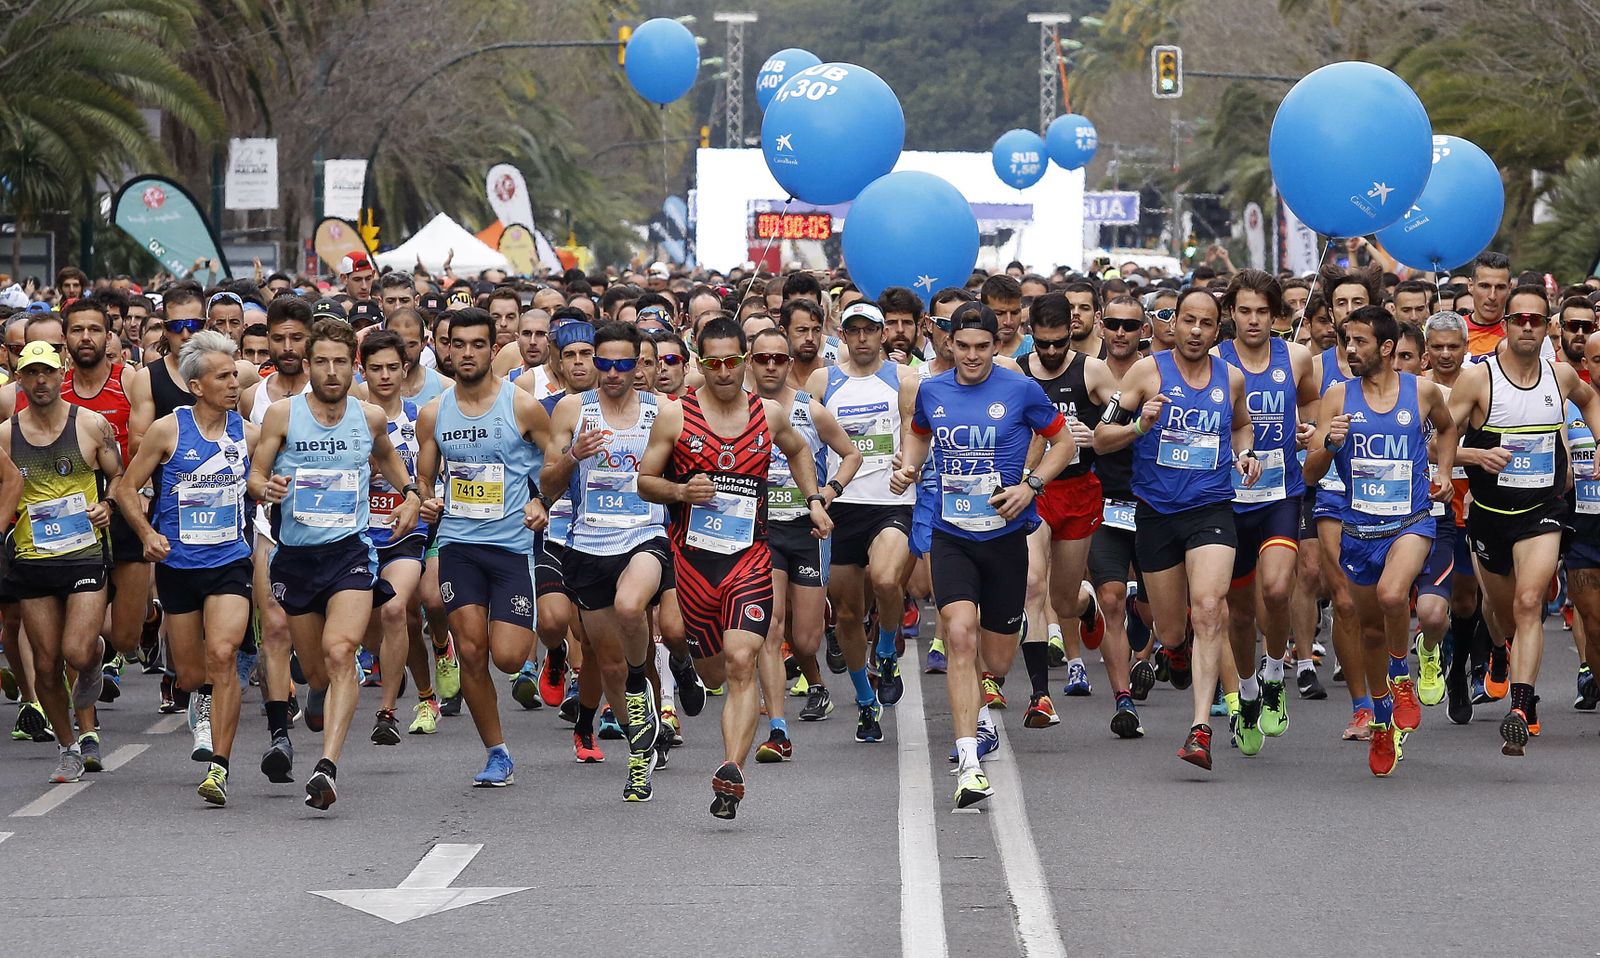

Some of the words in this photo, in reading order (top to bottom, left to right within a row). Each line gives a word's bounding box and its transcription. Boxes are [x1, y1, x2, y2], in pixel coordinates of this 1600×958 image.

[1011, 151, 1039, 164] SUB
[757, 213, 832, 241] 00:00:05
[1168, 405, 1221, 433] RCM
[442, 426, 489, 443] nerja
[937, 425, 996, 450] RCM
[295, 437, 348, 455] nerja
[1352, 433, 1409, 460] RCM
[303, 455, 342, 463] ATLETISMO
[1172, 448, 1189, 462] 80
[1513, 456, 1531, 470] 85
[456, 482, 485, 498] 7413
[1361, 482, 1386, 496] 164
[314, 494, 324, 507] 7
[368, 496, 395, 509] 531
[597, 495, 623, 508] 134
[955, 498, 971, 512] 69
[190, 511, 216, 524] 107
[703, 515, 723, 531] 26
[45, 522, 61, 536] 89
[74, 578, 97, 589] joma
